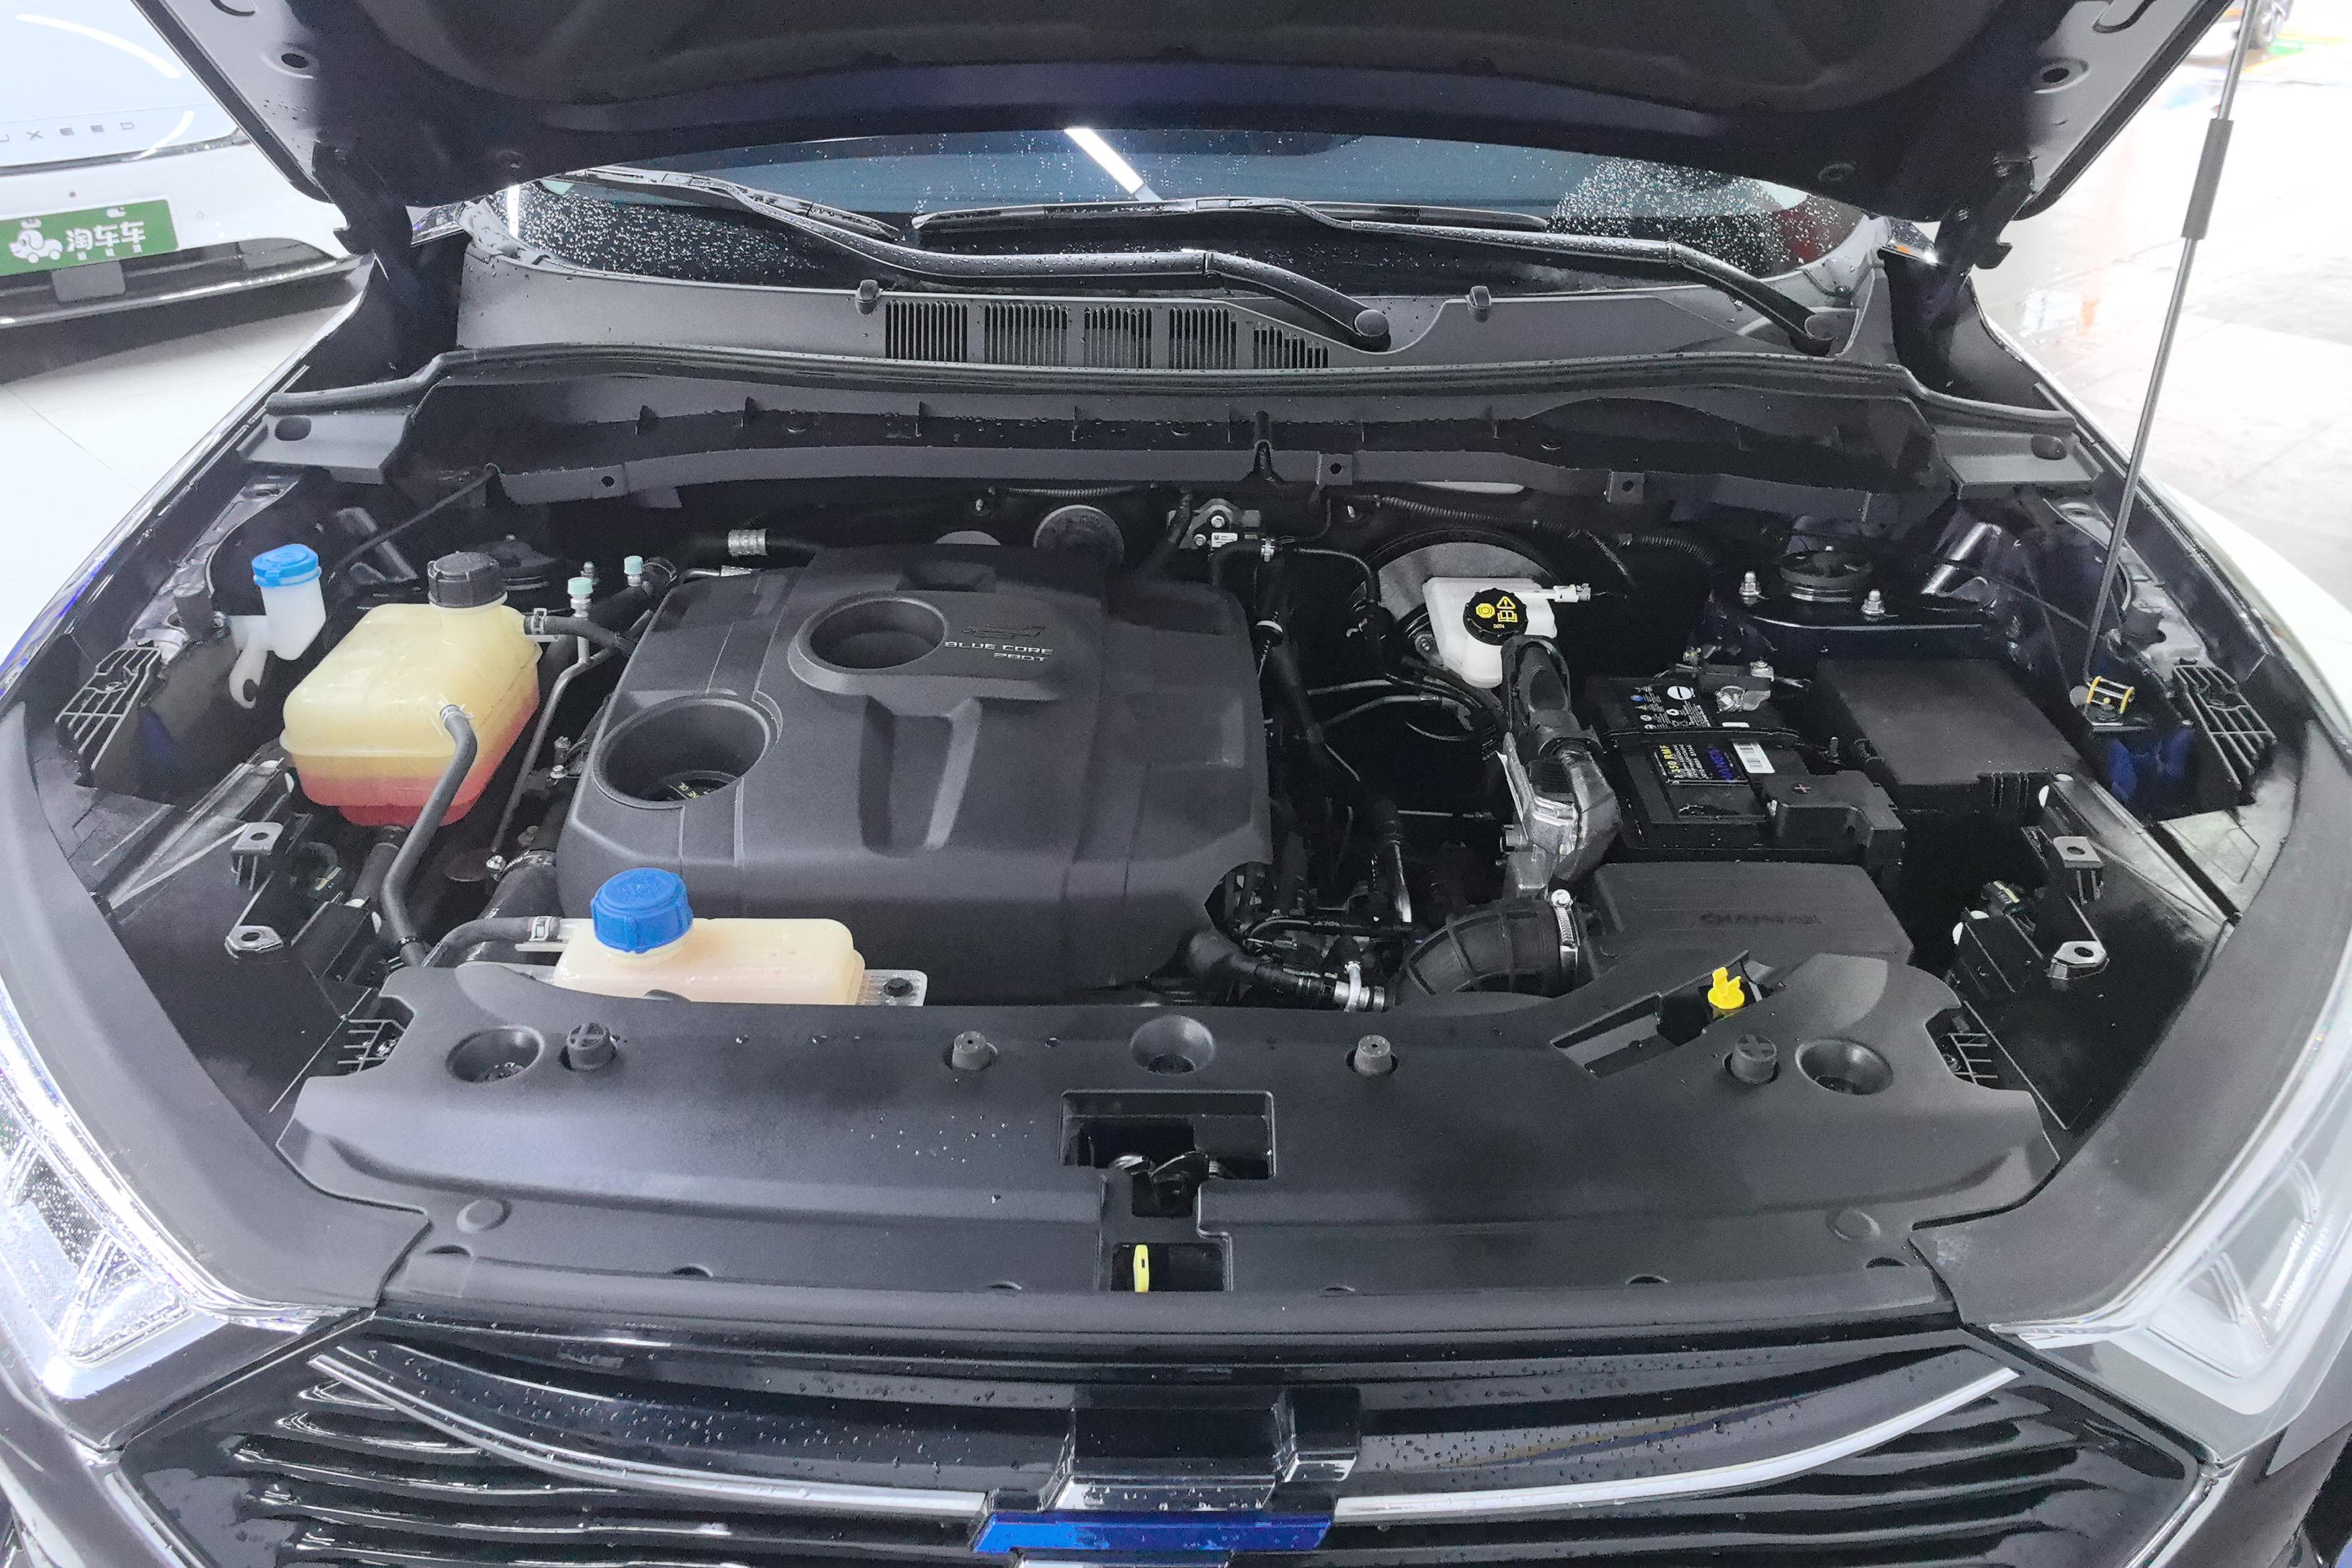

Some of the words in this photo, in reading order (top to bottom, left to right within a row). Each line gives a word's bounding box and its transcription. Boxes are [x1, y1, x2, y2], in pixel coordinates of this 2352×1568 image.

[66, 220, 146, 253] 淘车车
[945, 641, 997, 650] BLUE
[1002, 644, 1053, 656] CORE
